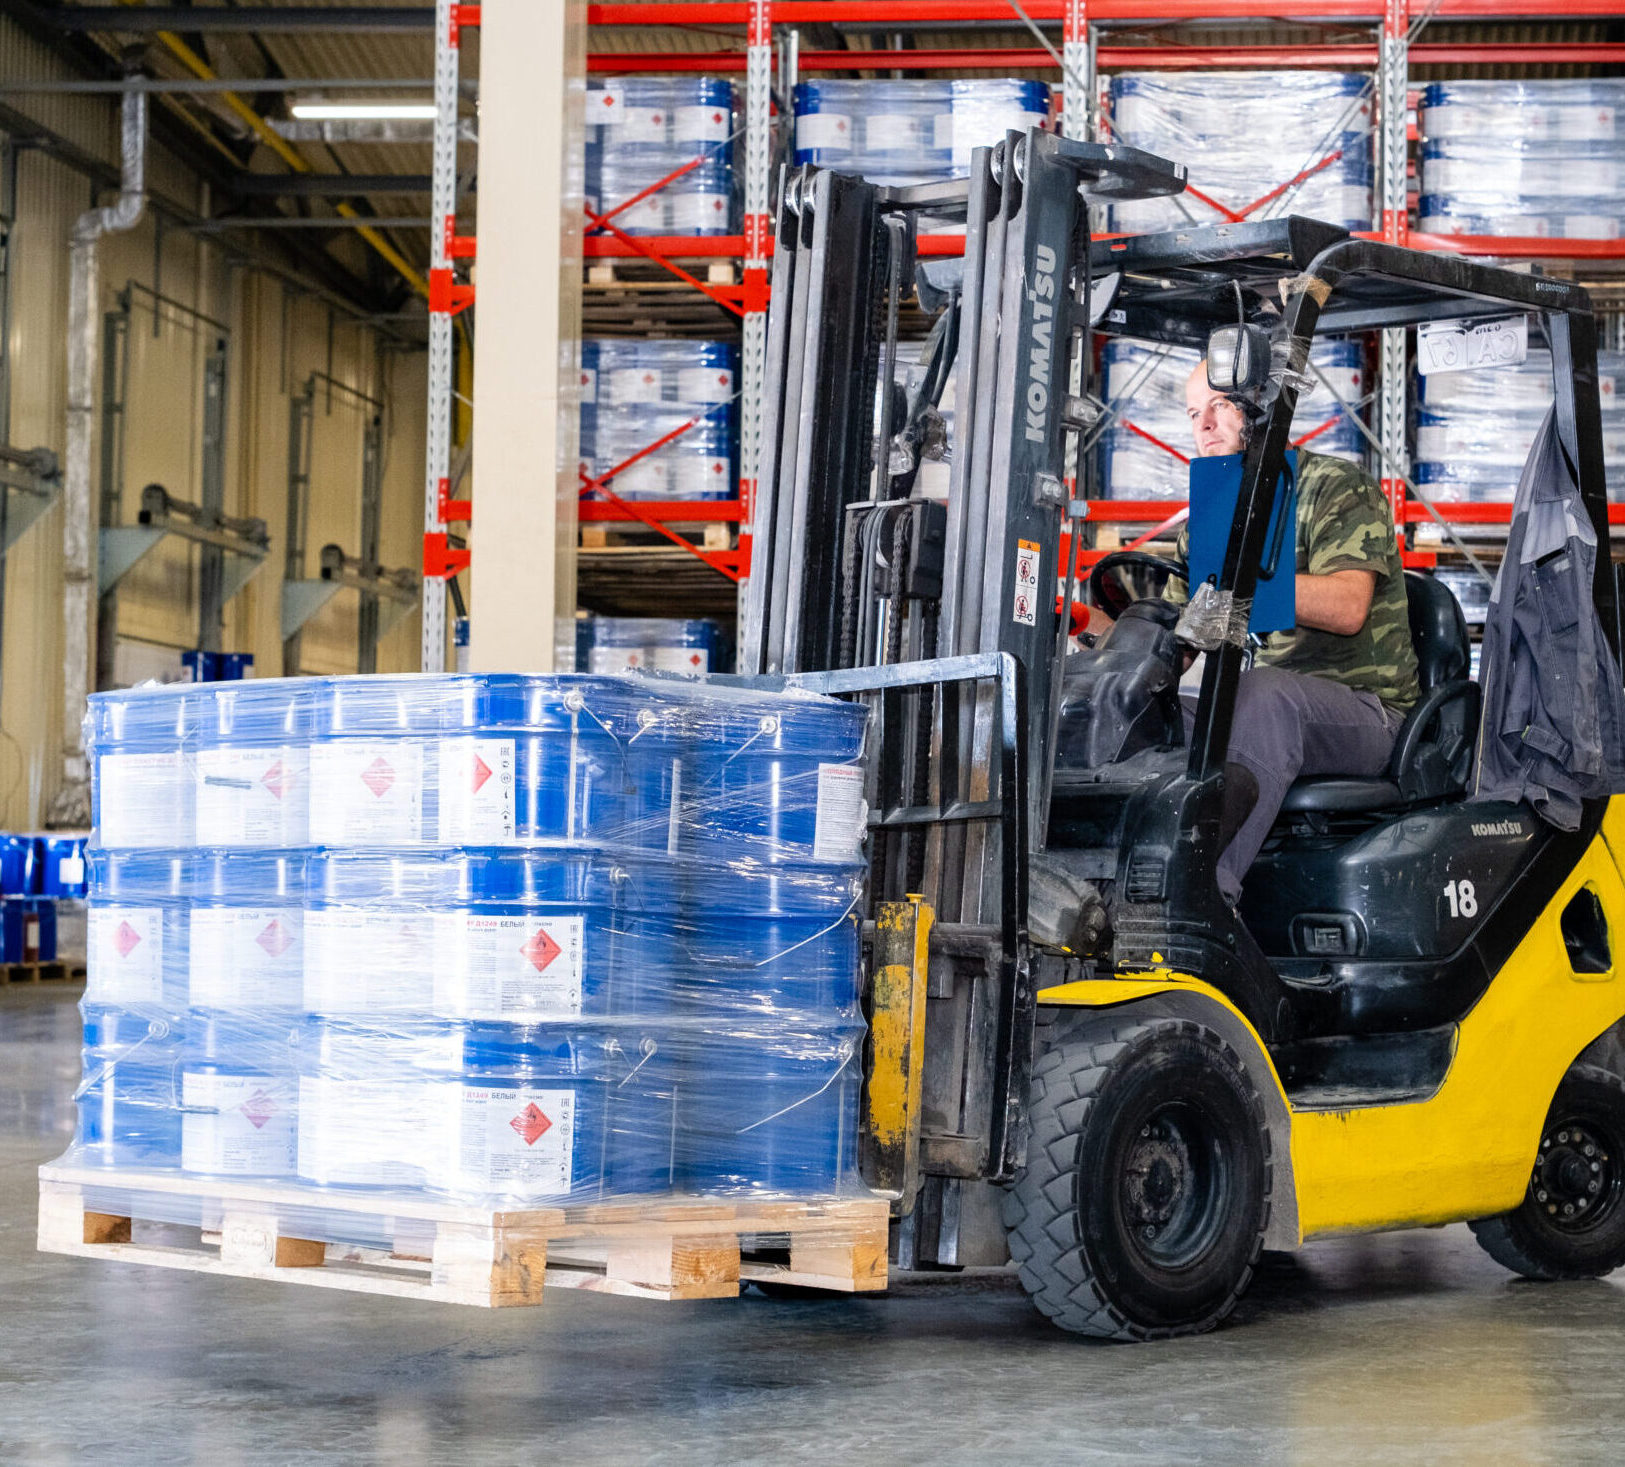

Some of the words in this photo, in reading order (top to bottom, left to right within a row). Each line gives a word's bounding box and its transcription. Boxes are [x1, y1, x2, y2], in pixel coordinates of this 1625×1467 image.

[1025, 243, 1057, 443] KOMATSU
[1471, 819, 1522, 836] KOMATSU
[1443, 879, 1478, 918] 18
